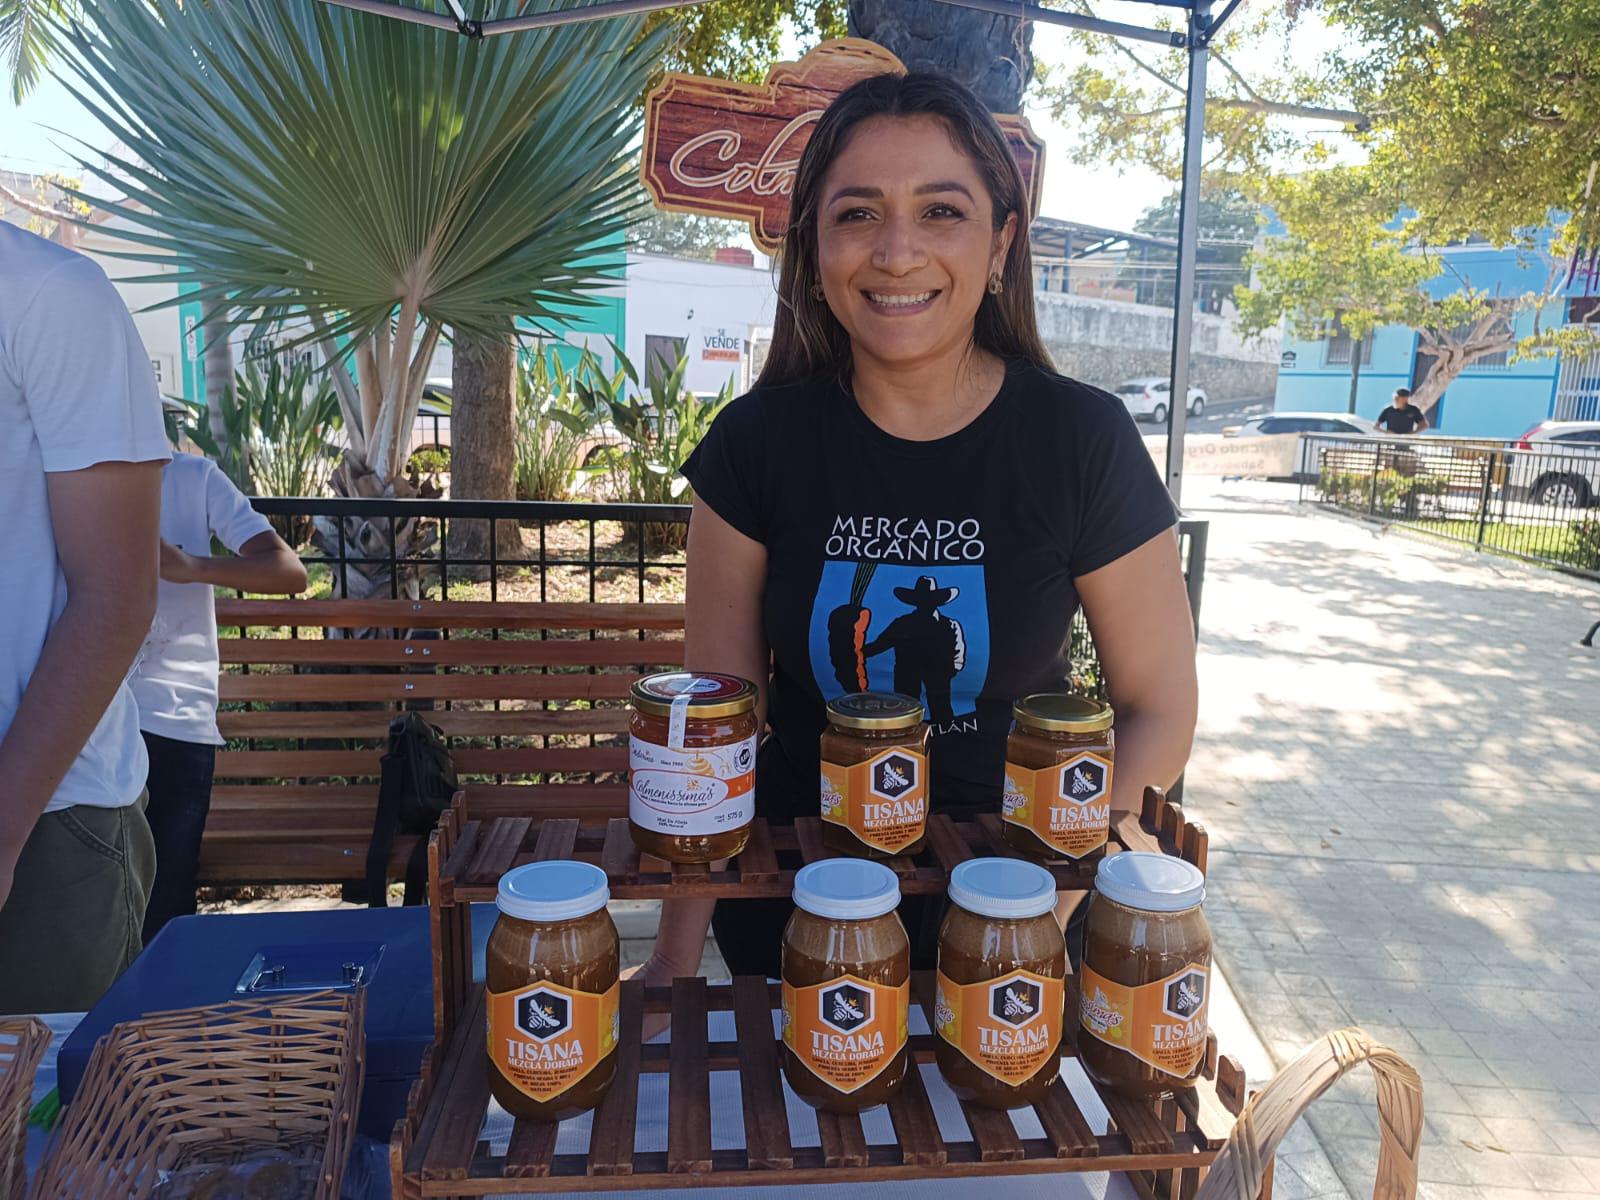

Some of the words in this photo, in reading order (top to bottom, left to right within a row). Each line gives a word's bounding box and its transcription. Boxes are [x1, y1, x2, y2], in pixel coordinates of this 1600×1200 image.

[704, 336, 740, 349] VENDE
[832, 514, 980, 540] MERCADO
[826, 536, 985, 561] ORGÁNICO
[861, 798, 925, 820] TISANA
[1048, 804, 1110, 823] TISANA
[863, 818, 895, 828] MEZCLA
[1050, 822, 1080, 831] MEZCLA
[810, 1030, 885, 1053] TISANA
[977, 1023, 1049, 1047] TISANA
[505, 1038, 583, 1061] TISANA
[979, 1044, 1016, 1055] MEZCLA
[1018, 1039, 1049, 1054] DORADA
[1152, 1040, 1186, 1050] MEZCLA
[811, 1047, 847, 1061] MEZCLA
[849, 1047, 885, 1061] DORADA
[508, 1057, 542, 1070] MEZCLA
[544, 1056, 583, 1069] DORADA
